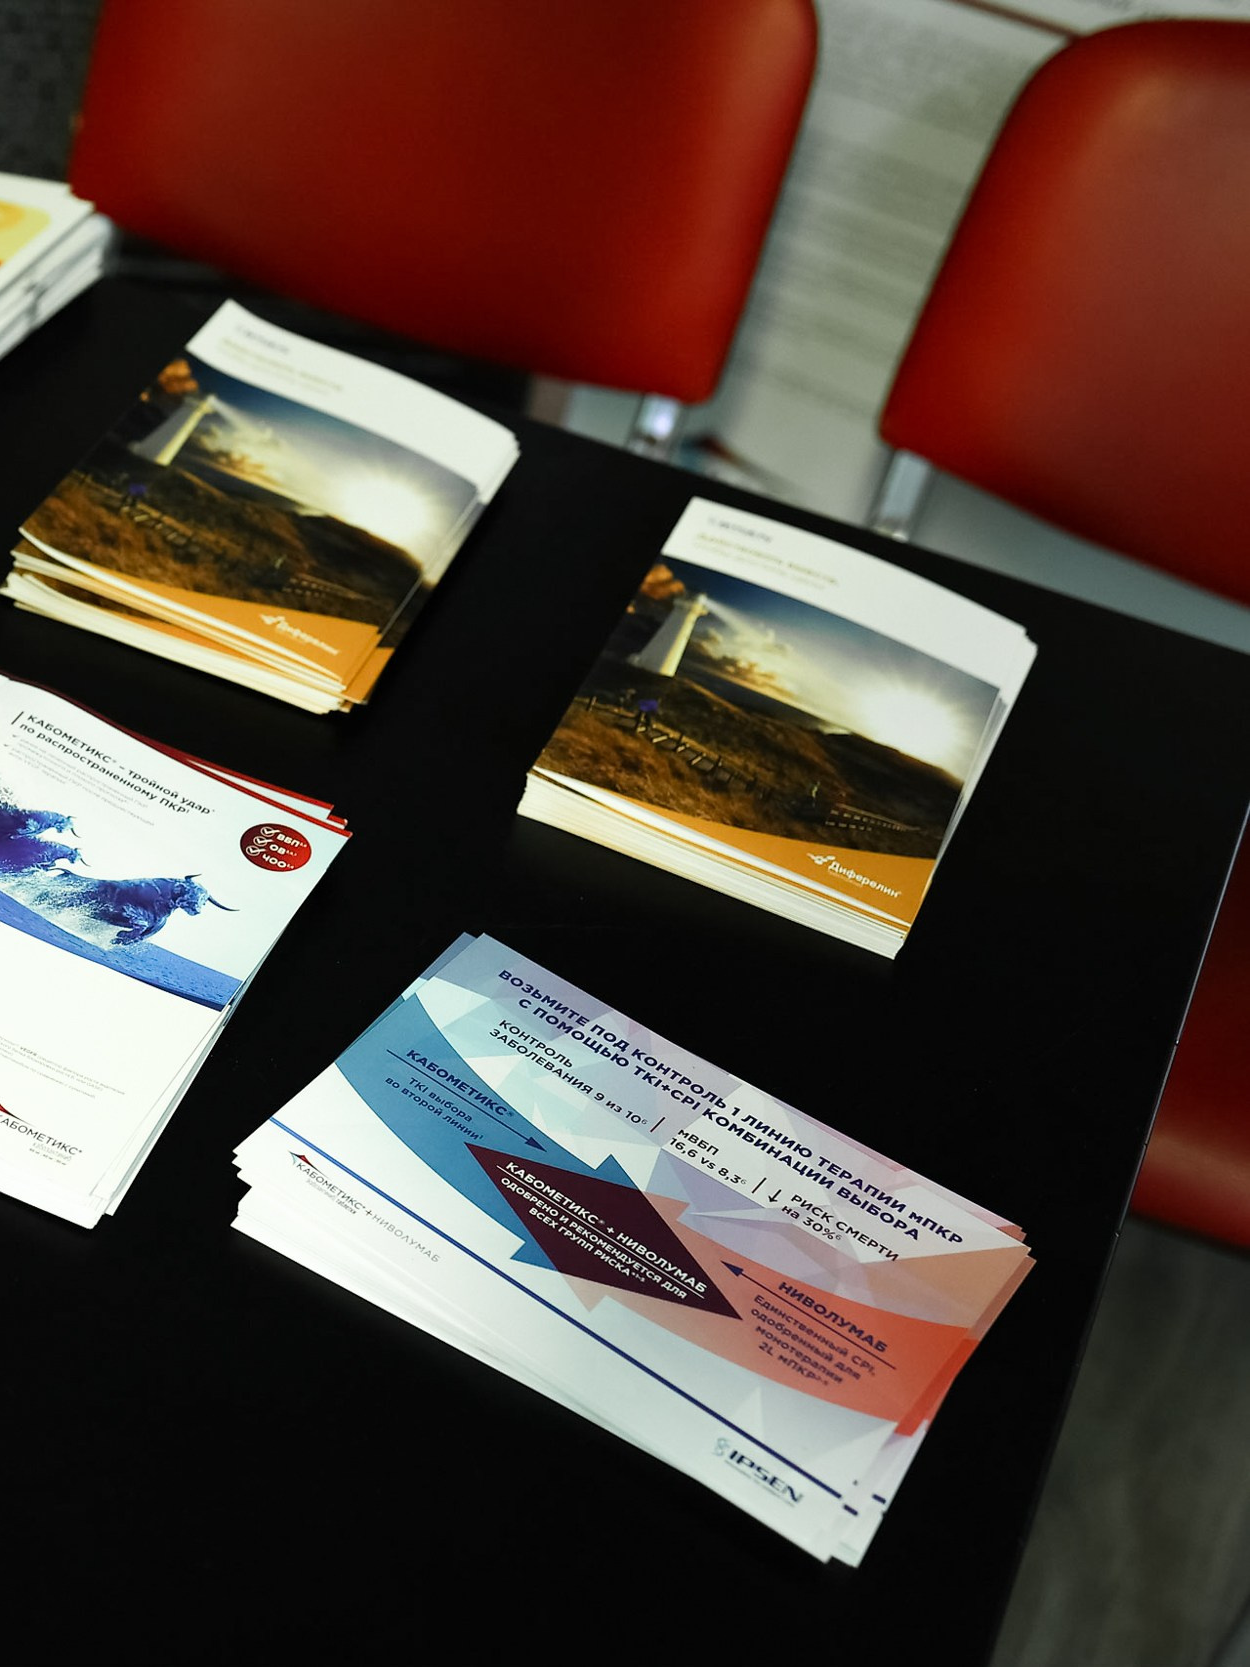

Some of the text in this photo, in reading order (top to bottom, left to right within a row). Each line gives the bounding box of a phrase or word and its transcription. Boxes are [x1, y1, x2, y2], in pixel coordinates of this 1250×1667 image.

[18, 723, 36, 734] по
[35, 731, 158, 801] распространенному
[124, 768, 181, 799] тройной
[487, 1027, 594, 1094] ЗАБОЛЕВАНИЯ
[592, 1091, 606, 1102] 9
[604, 1099, 623, 1113] из
[497, 1019, 575, 1068] КОНТРОЛЬ
[384, 1077, 401, 1089] во
[399, 1086, 444, 1116] второй
[426, 1090, 475, 1123] выбора
[496, 969, 964, 1247] ВОЗЬМИТЕ ПОД КОНТРОЛЬ 1 ЛИНИЮ ТЕРАПИИ мПКР
[516, 997, 922, 1241] С ПОМОЩЬЮ TKI+CPI КОМБИНАЦИИ ВЫБОРА
[667, 1137, 698, 1159] 16,6
[697, 1156, 716, 1170] vs
[676, 1127, 719, 1156] мВБП
[370, 1213, 441, 1263] НИВОЛУМАБ
[498, 1176, 687, 1300] ОДОБРЕНО И РЕКОМЕНДУЕТСЯ ДЛЯ
[528, 1207, 558, 1228] ВСЕХ
[557, 1225, 595, 1252] ГРУПП
[780, 1204, 801, 1219] на
[789, 1192, 900, 1263] РИСК СМЕРТИ
[615, 1231, 707, 1293] НИВОЛУМАБ
[749, 1306, 861, 1381] одобренный для
[752, 1293, 849, 1358] Единственный
[777, 1280, 889, 1354] НИВОЛУМАБ
[754, 1324, 844, 1385] монотерапии
[757, 1340, 776, 1356] 2L
[727, 1448, 805, 1505] IPSEN
